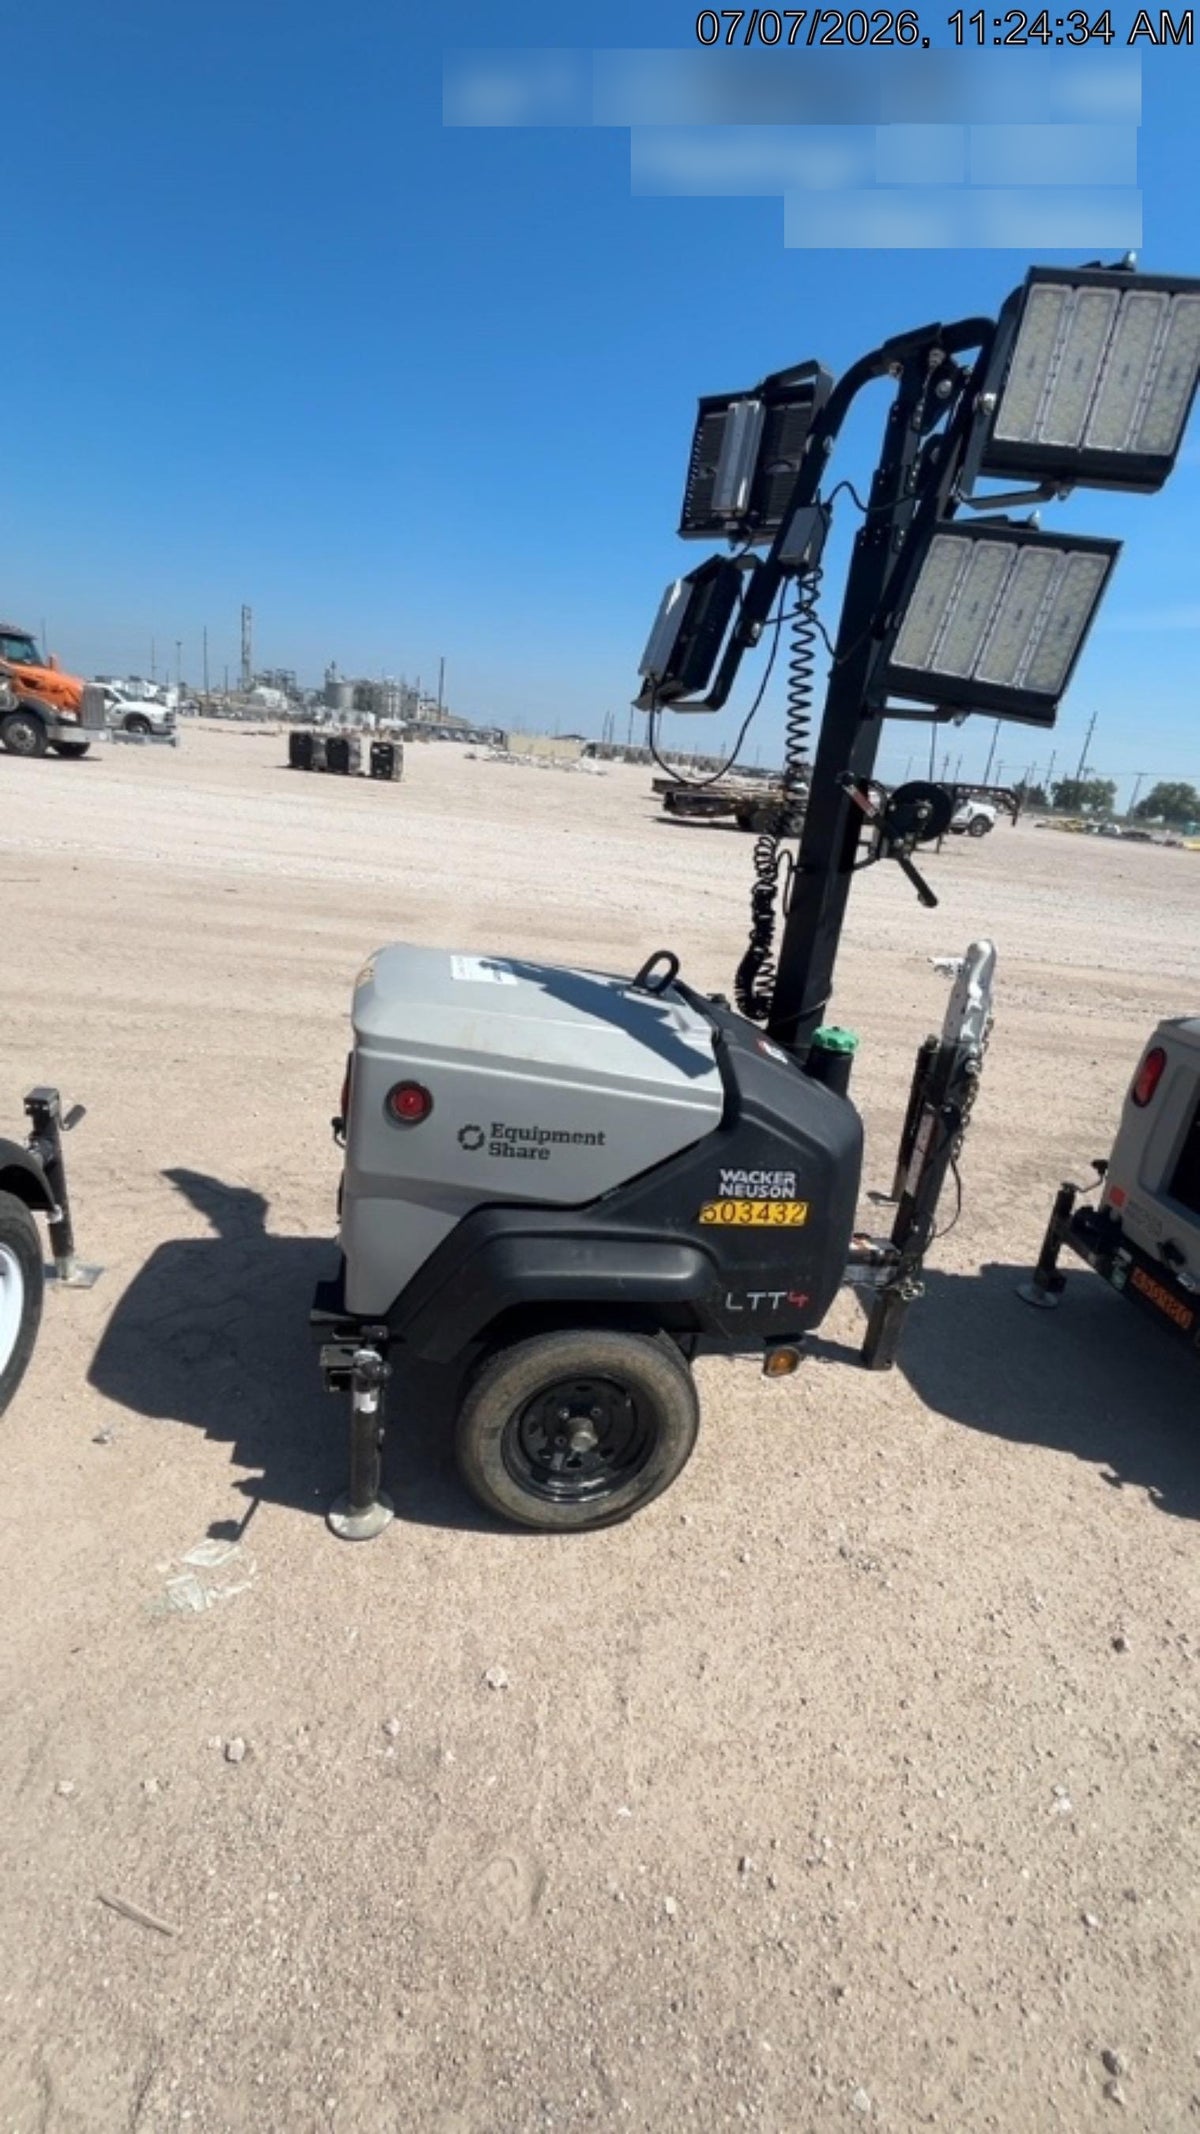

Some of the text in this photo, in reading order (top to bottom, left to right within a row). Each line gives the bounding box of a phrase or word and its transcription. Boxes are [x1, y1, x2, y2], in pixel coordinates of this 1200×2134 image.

[491, 1122, 606, 1146] Equipment
[488, 1141, 551, 1160] Share
[719, 1168, 797, 1185] WACKER
[719, 1182, 796, 1198] NEUSON
